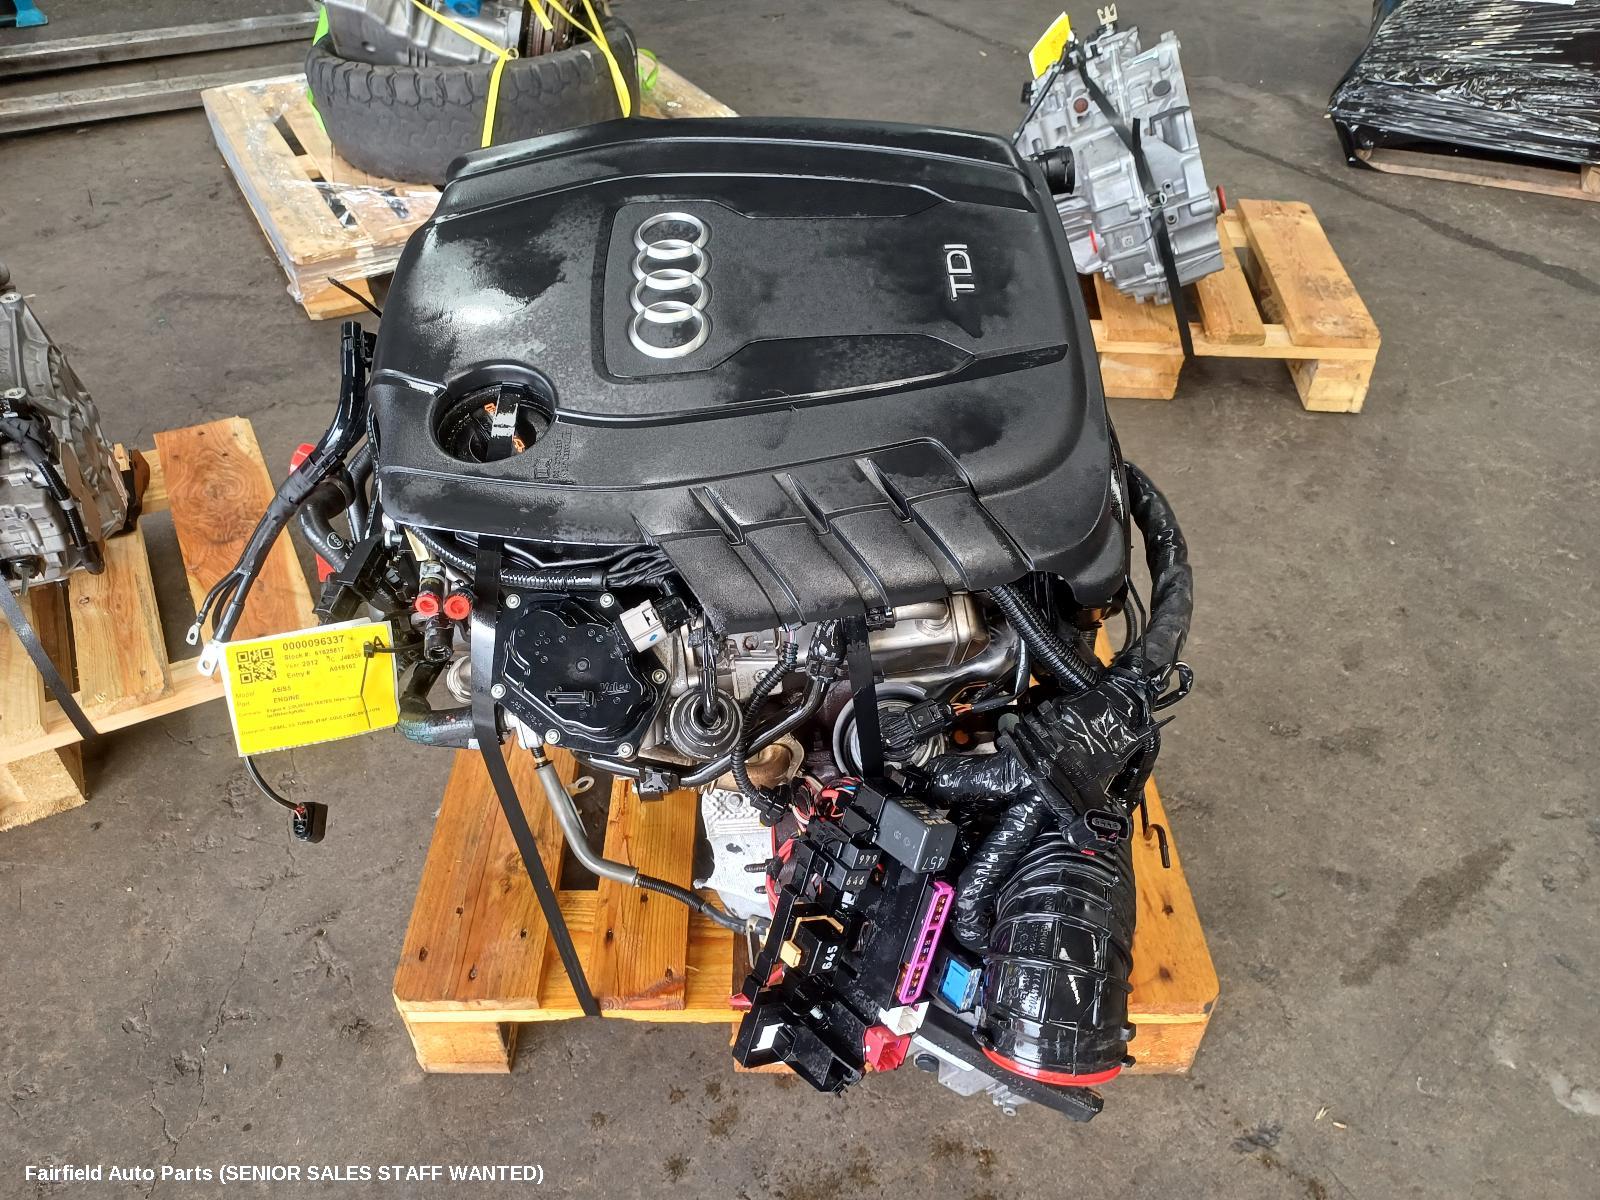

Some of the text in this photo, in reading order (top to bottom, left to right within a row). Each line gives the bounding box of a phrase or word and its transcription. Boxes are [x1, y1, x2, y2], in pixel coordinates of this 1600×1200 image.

[944, 243, 976, 300] TDI
[282, 634, 345, 651] 0000096337
[302, 660, 319, 668] 2012
[273, 694, 300, 704] ENGINE
[921, 855, 945, 870] 457
[821, 945, 839, 970] 645
